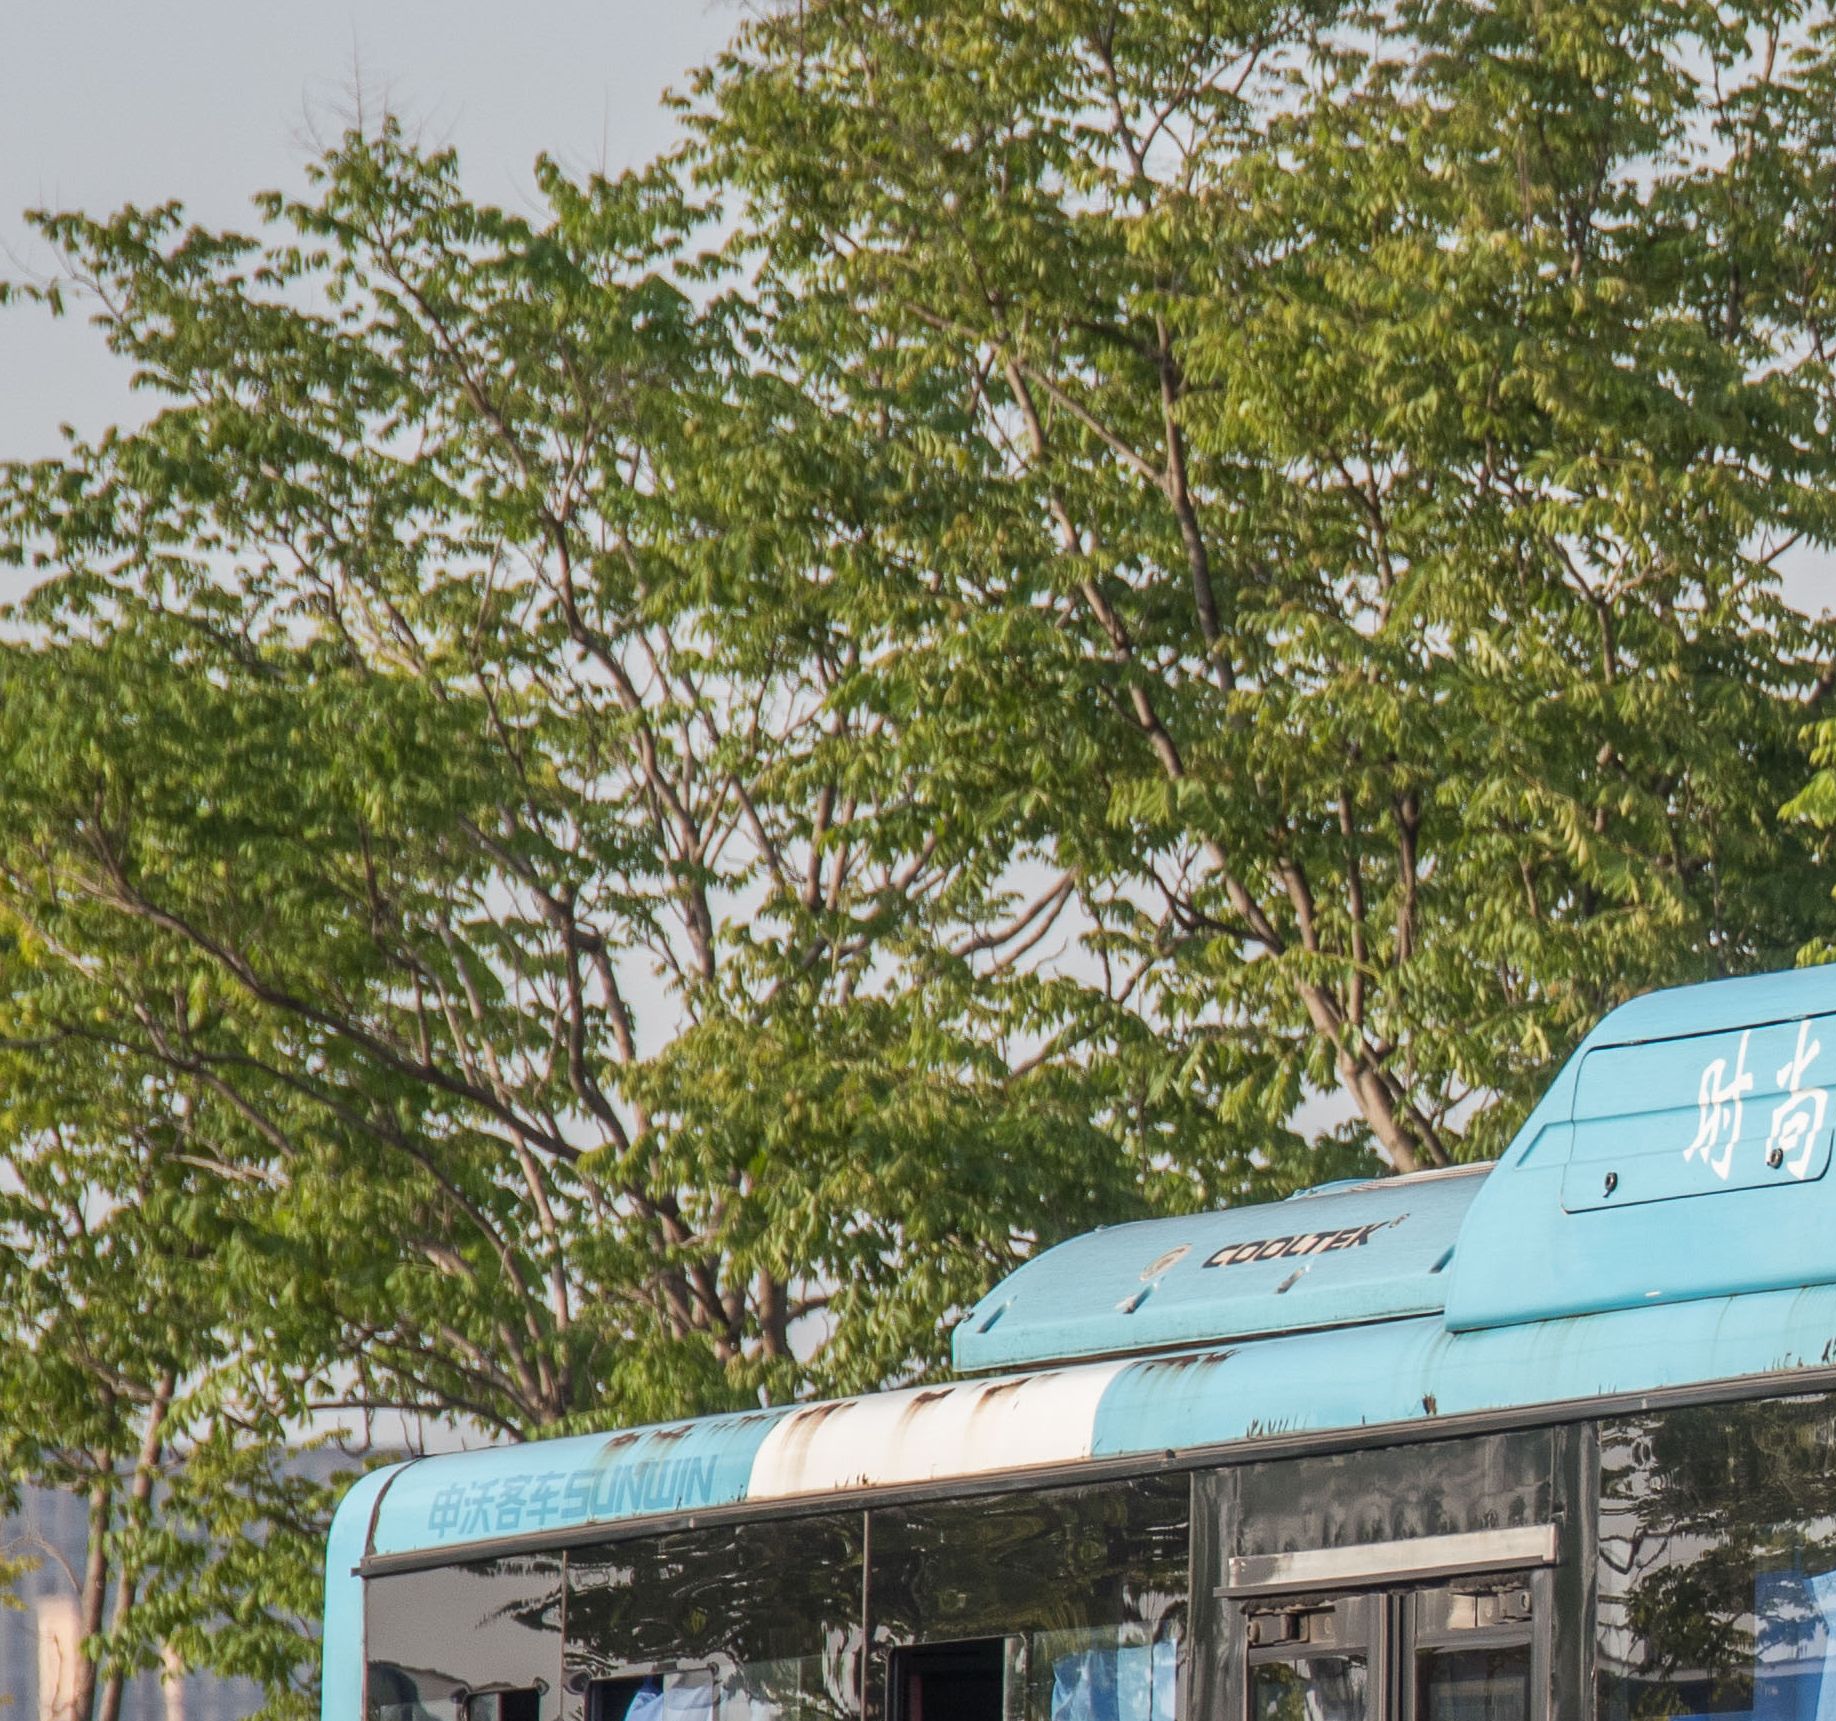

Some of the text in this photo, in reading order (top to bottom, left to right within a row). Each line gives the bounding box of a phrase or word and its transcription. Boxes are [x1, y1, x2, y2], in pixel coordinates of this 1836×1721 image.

[1202, 1220, 1389, 1269] COOLTEK
[428, 1455, 719, 1538] 申沃客车 SUNWIN
